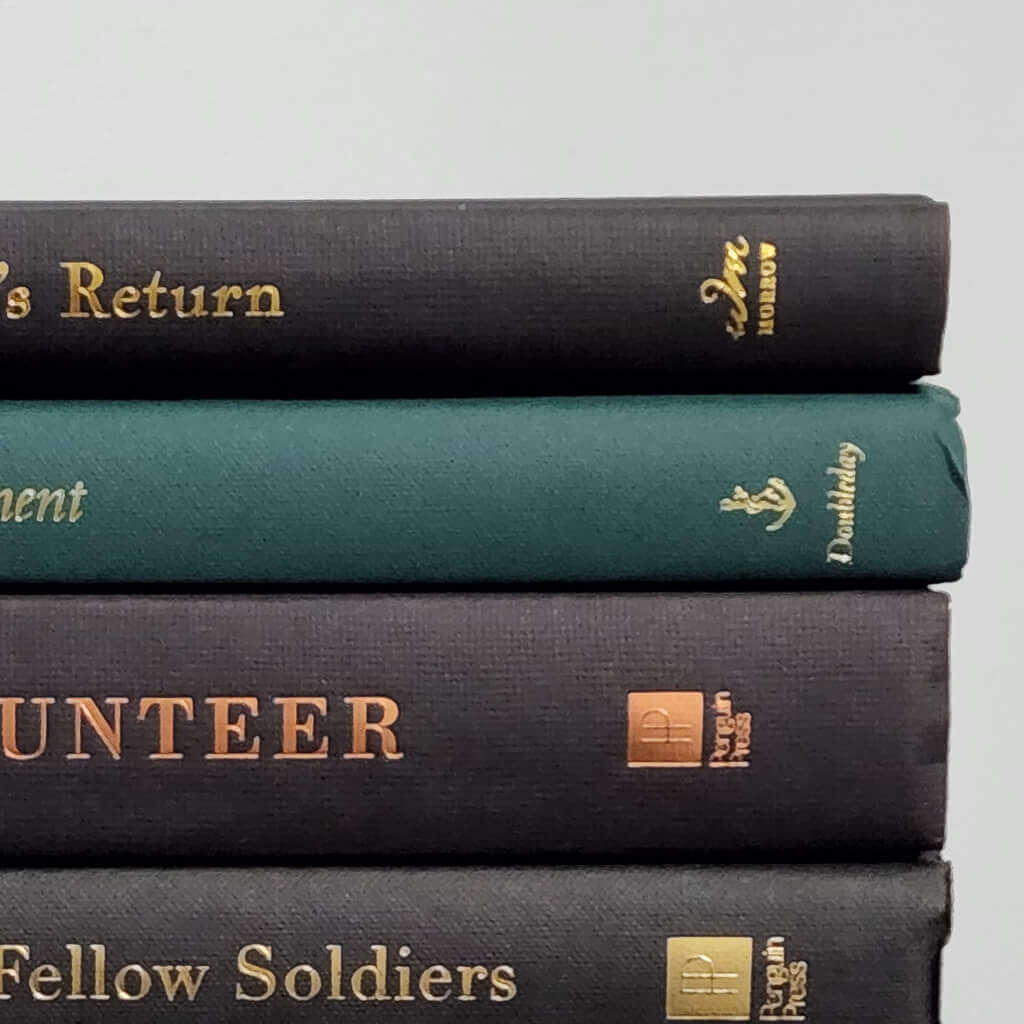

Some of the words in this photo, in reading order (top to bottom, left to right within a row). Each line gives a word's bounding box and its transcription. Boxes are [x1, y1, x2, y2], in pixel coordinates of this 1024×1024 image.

[59, 261, 285, 320] Return
[757, 241, 777, 337] MORROW
[826, 441, 866, 565] Doubleday
[709, 691, 732, 768] Penguin
[730, 712, 752, 768] Press
[235, 942, 518, 1002] Soldiers
[759, 936, 787, 1021] Penguin
[783, 960, 808, 1021] Press
